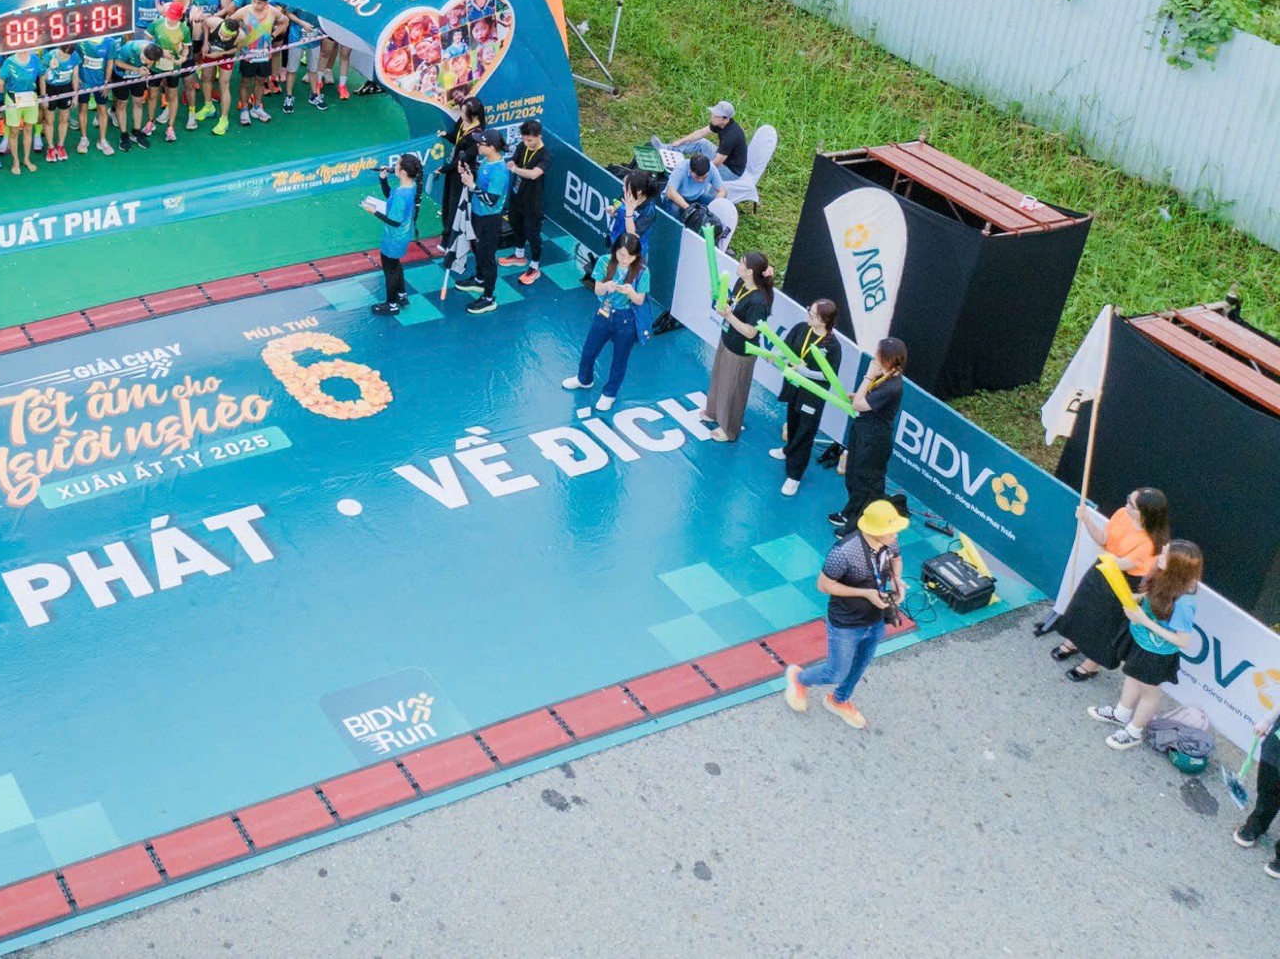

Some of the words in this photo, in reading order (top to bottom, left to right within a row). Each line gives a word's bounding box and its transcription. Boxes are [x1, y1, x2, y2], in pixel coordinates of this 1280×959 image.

[64, 200, 141, 236] PHÁT
[852, 248, 887, 313] BIDV
[72, 357, 121, 379] GIẢI
[85, 377, 168, 420] ấm
[171, 374, 222, 401] cho
[261, 331, 393, 420] 6
[124, 392, 273, 456] nghèo
[393, 425, 540, 509] VỀ
[528, 390, 744, 478] ĐÍCH
[894, 410, 995, 497] BIDV
[56, 470, 128, 500] XUÂN
[134, 460, 165, 480] ẤT
[209, 433, 271, 461] 2025
[1, 503, 275, 628] PHÁT
[342, 700, 408, 738] BIDV
[370, 722, 438, 755] Run
